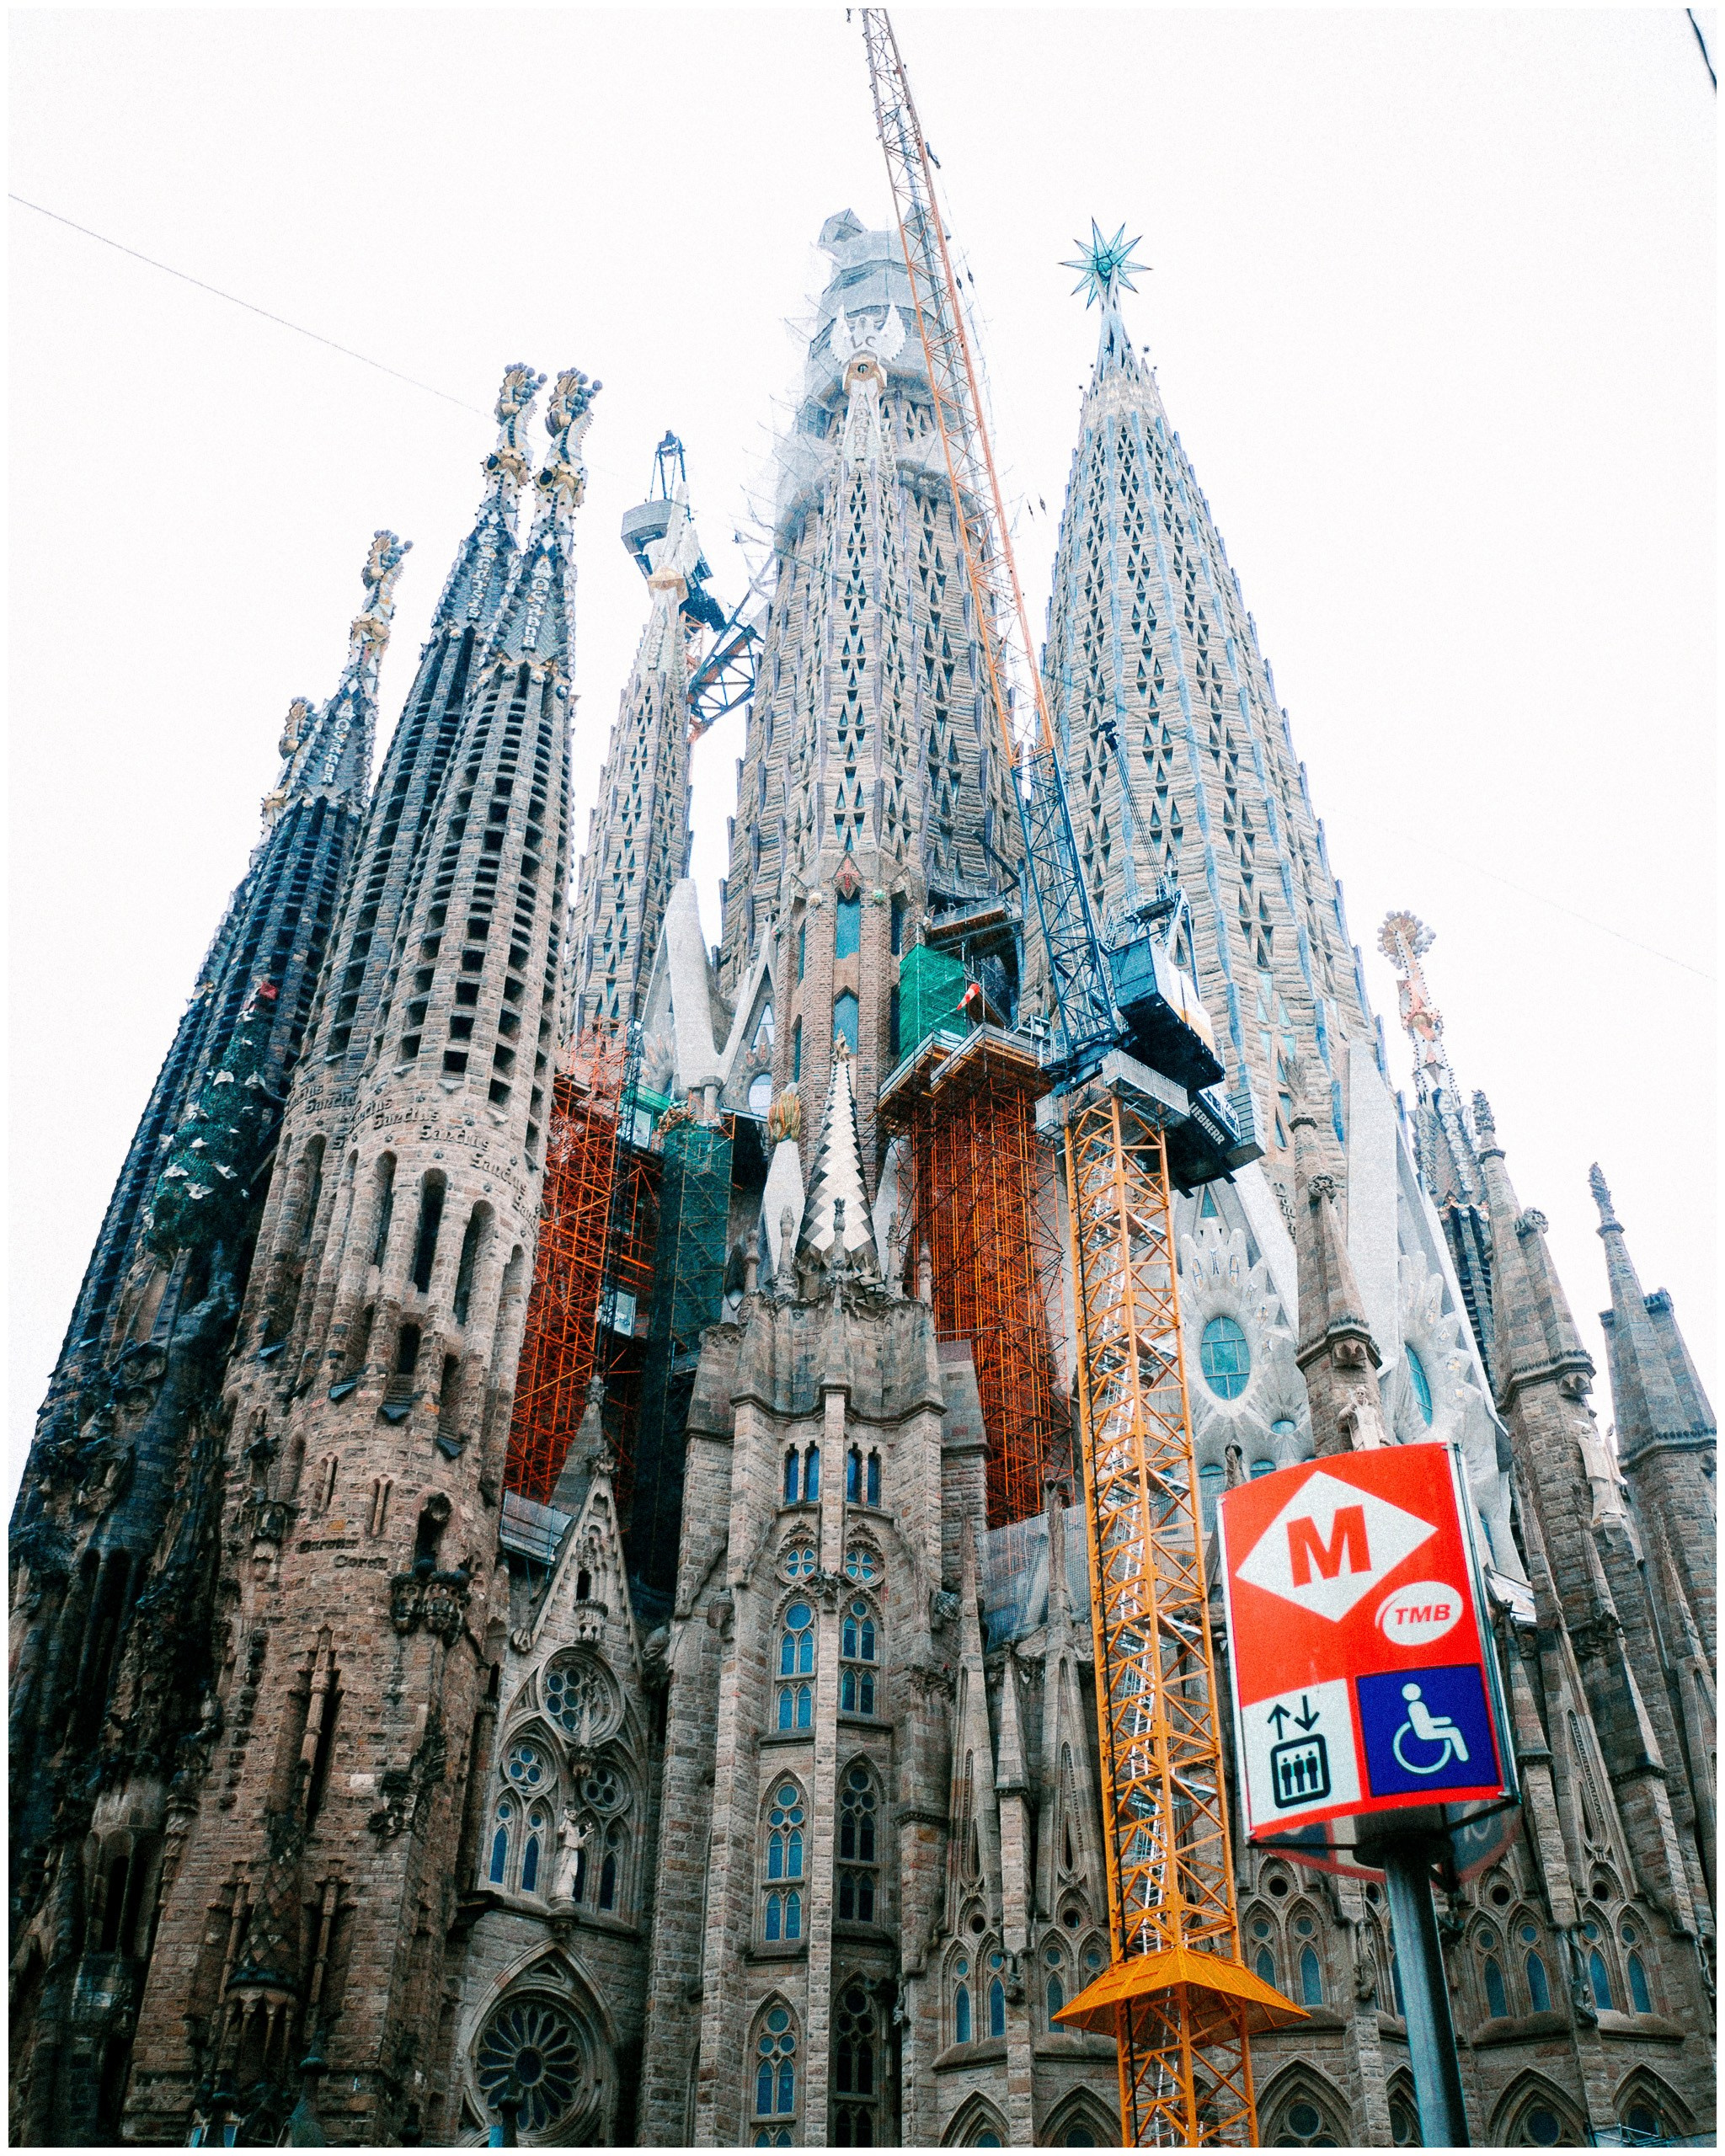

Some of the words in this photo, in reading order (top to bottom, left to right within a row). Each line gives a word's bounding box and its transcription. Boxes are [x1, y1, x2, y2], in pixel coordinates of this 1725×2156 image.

[1188, 1102, 1225, 1145] LIEBHERR
[1286, 1504, 1372, 1588] M
[1396, 1604, 1450, 1625] TMB
